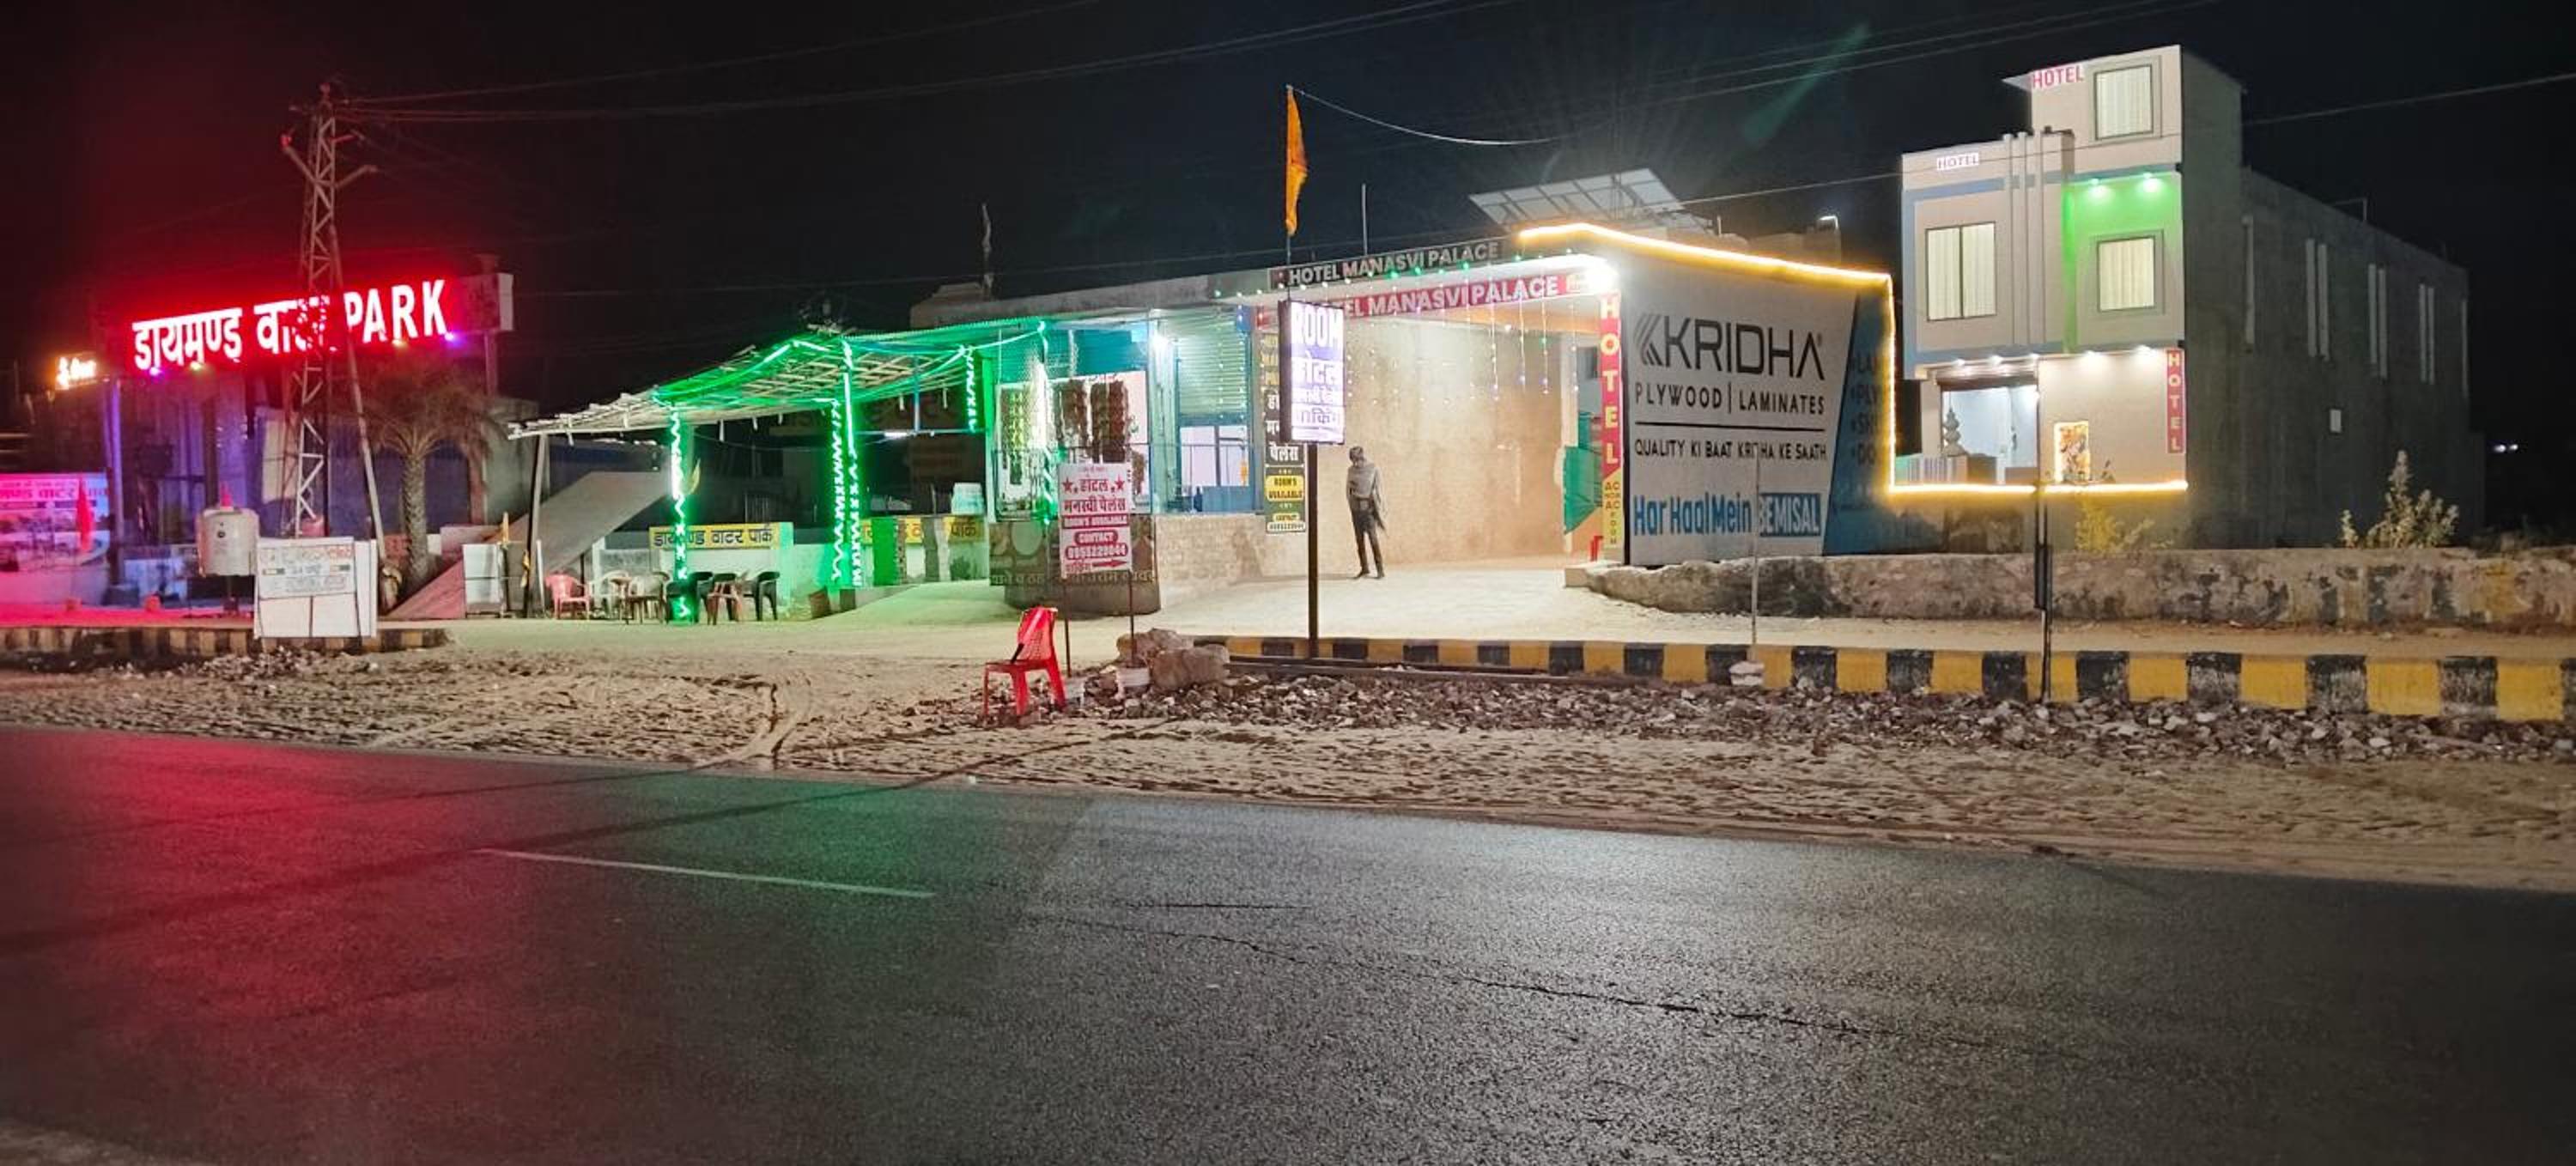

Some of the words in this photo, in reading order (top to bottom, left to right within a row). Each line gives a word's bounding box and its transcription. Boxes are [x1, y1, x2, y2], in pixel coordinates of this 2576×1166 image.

[2032, 66, 2084, 88] HOTEL
[1938, 154, 1978, 170] HOTEL
[1289, 263, 1340, 286] HOTEL
[1342, 252, 1425, 279] MANASVI
[1428, 241, 1499, 265] PALACE
[343, 279, 447, 343] PARK
[1368, 285, 1468, 316] MANASVI
[1471, 275, 1559, 307] PALACE
[1291, 302, 1344, 352] ROOM
[1601, 299, 1620, 464] HOTEL
[1636, 382, 1722, 410] PLYWOOD
[1738, 389, 1826, 416] LAMINATES
[2169, 351, 2182, 451] HOTEL
[1635, 439, 1686, 459] QUALITY
[1691, 440, 1702, 459] KI
[1705, 440, 1733, 459] BAAT
[1779, 443, 1792, 460] KE
[1795, 444, 1827, 461] SAATH
[1633, 494, 1666, 536] Har
[710, 529, 744, 544] वाटर
[1078, 532, 1115, 544] CONTACT
